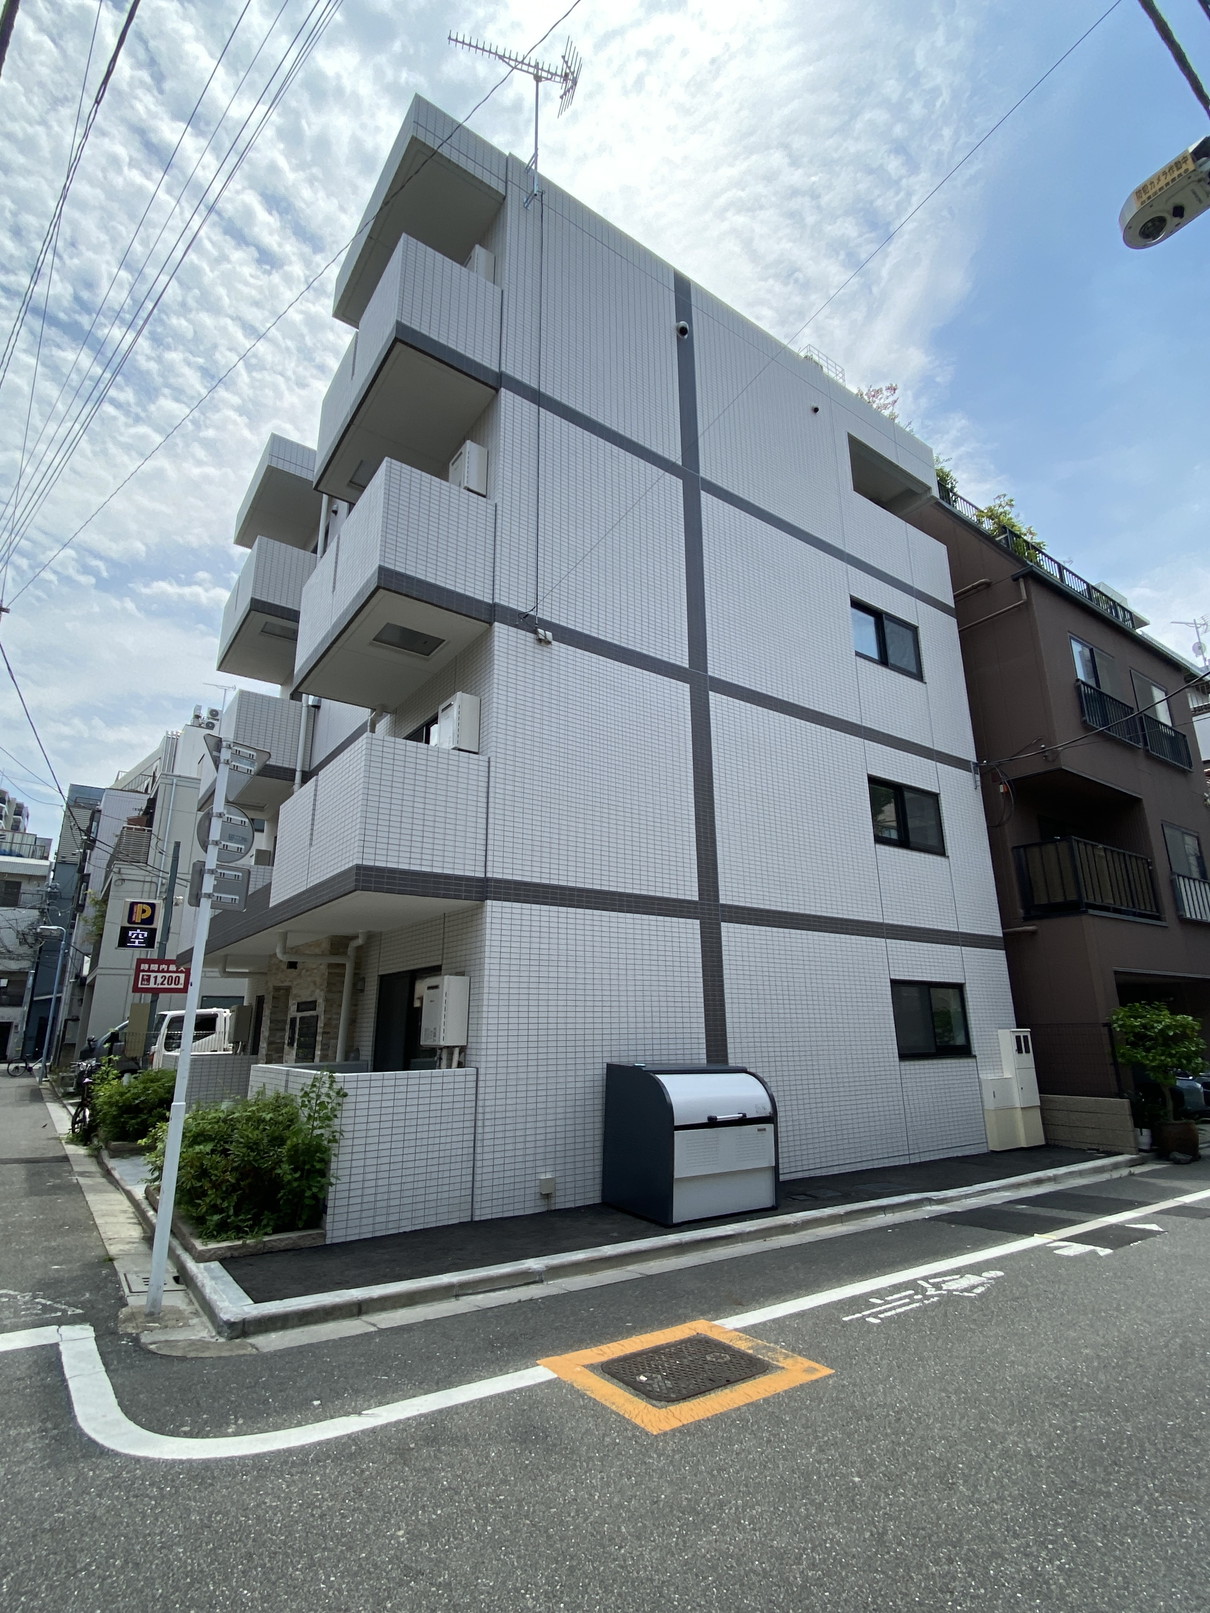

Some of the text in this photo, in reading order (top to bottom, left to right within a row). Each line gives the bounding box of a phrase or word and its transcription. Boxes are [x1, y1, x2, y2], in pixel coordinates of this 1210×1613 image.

[135, 904, 152, 923] P
[127, 929, 148, 946] 空
[153, 975, 183, 986] 1,200
